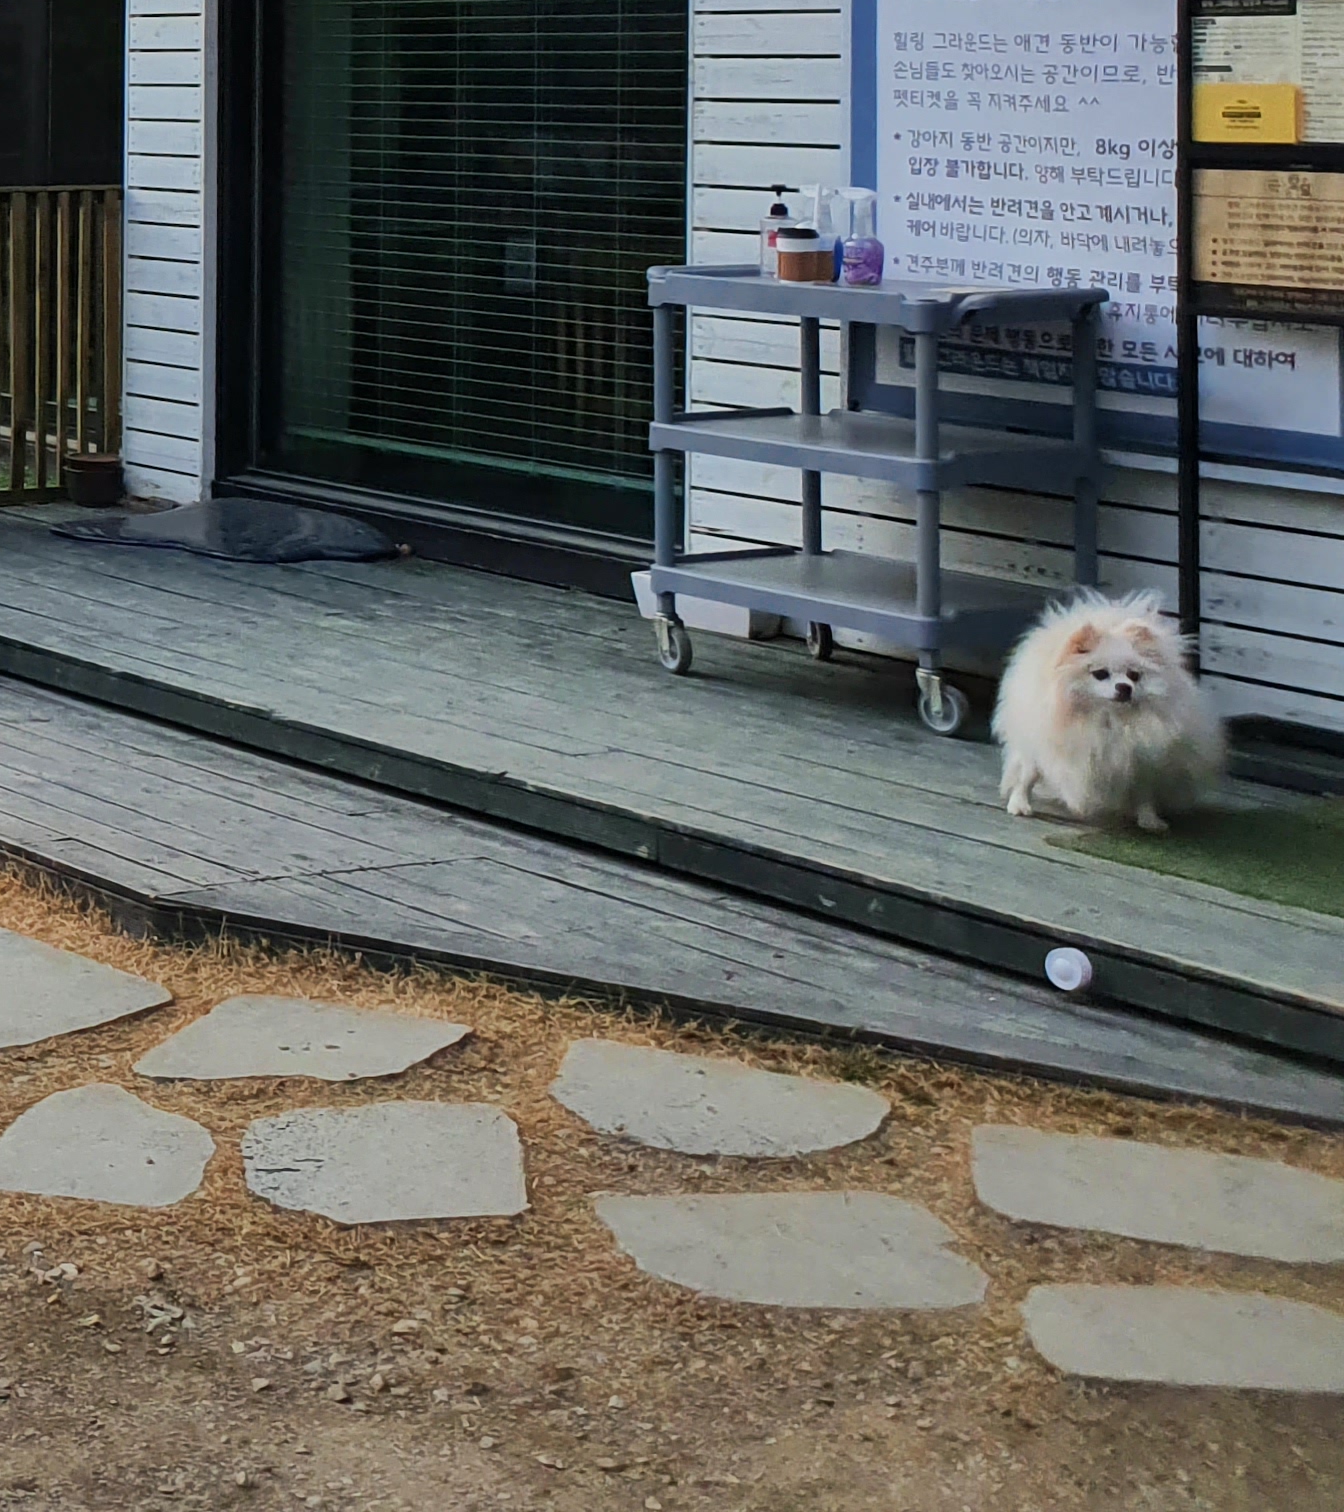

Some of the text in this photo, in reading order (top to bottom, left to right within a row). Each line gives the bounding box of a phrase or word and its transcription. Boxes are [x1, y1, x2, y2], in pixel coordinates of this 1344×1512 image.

[893, 31, 925, 51] 힐링
[932, 31, 1009, 54] 그라운드는
[1014, 33, 1050, 54] 애견
[1059, 33, 1118, 55] 동반이
[893, 60, 957, 81] 손님들도
[961, 62, 1036, 84] 찾아오시는
[1042, 64, 1147, 86] 공간이므로,
[893, 89, 959, 111] 펫티켓을
[967, 91, 982, 112] 꼭
[988, 93, 1070, 114] 지켜주세요
[907, 129, 954, 149] 강아지
[960, 131, 992, 152] 동반
[998, 133, 1081, 157] 공간이지만,
[1095, 138, 1131, 161] 8kg
[908, 156, 940, 178] 입장
[946, 158, 1030, 181] 불가합니다.
[1035, 164, 1065, 184] 양해
[906, 191, 1174, 228] 실내에서는 반려견을 안고 계시거나,
[906, 219, 937, 238] 케어
[940, 221, 1009, 245] 바랍니다.
[1013, 228, 1054, 250] (의자,
[1061, 231, 1110, 253] 바닥에
[906, 254, 966, 277] 견주분께
[971, 259, 1040, 284] 반려견의
[1047, 266, 1082, 288] 행동
[1089, 269, 1141, 294] 관리를
[1122, 339, 1158, 362] 모든
[1233, 347, 1297, 371] 대하여
